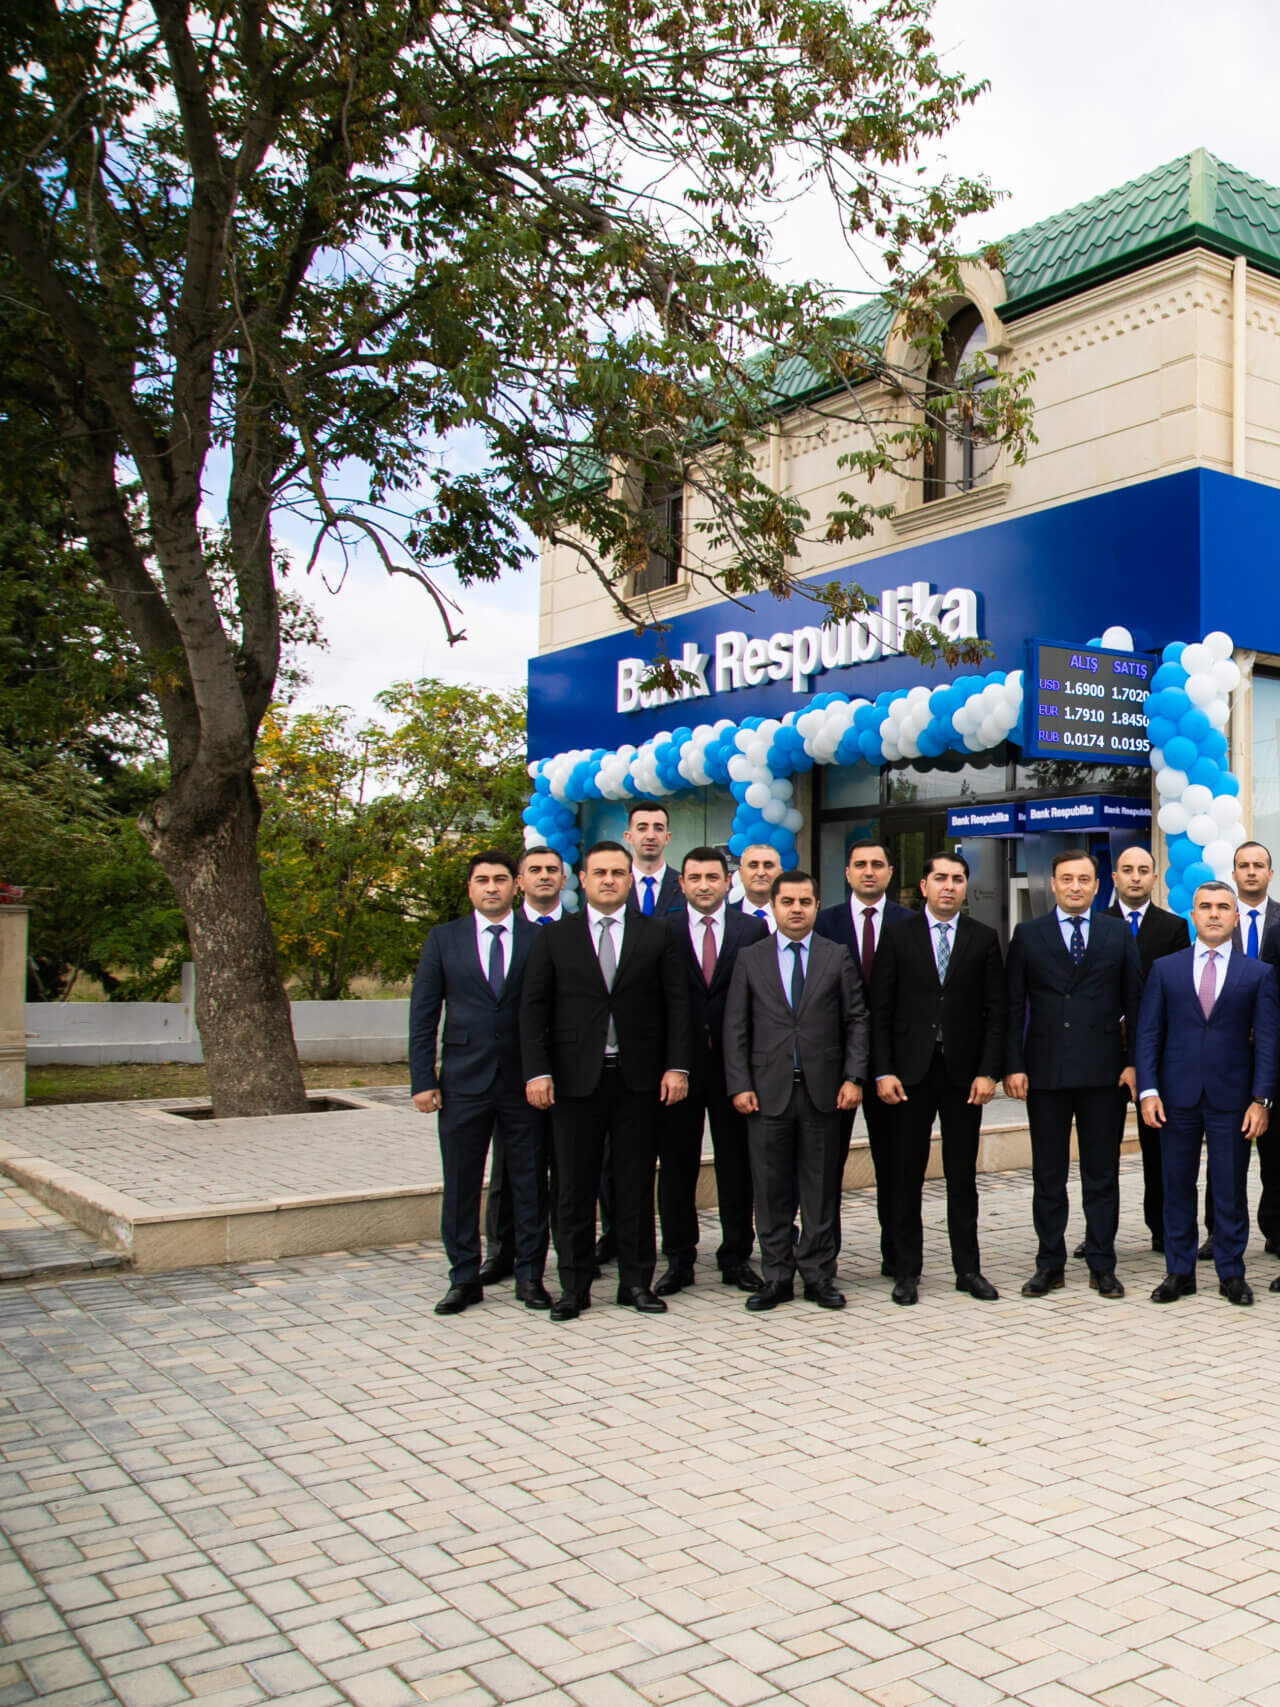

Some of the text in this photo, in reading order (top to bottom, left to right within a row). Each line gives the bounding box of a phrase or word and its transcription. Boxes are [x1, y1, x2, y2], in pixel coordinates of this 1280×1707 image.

[715, 581, 979, 693] Respublika
[1070, 655, 1148, 679] ALIŞ SATIŞ
[1039, 678, 1150, 703] USD 1.6900 1.7020
[1038, 704, 1150, 728] EUR 1.7910 1.8450
[1038, 730, 1150, 752] RUB 0.0174 0.0195
[951, 815, 969, 826] Bank
[1030, 804, 1094, 820] Bank Respublika
